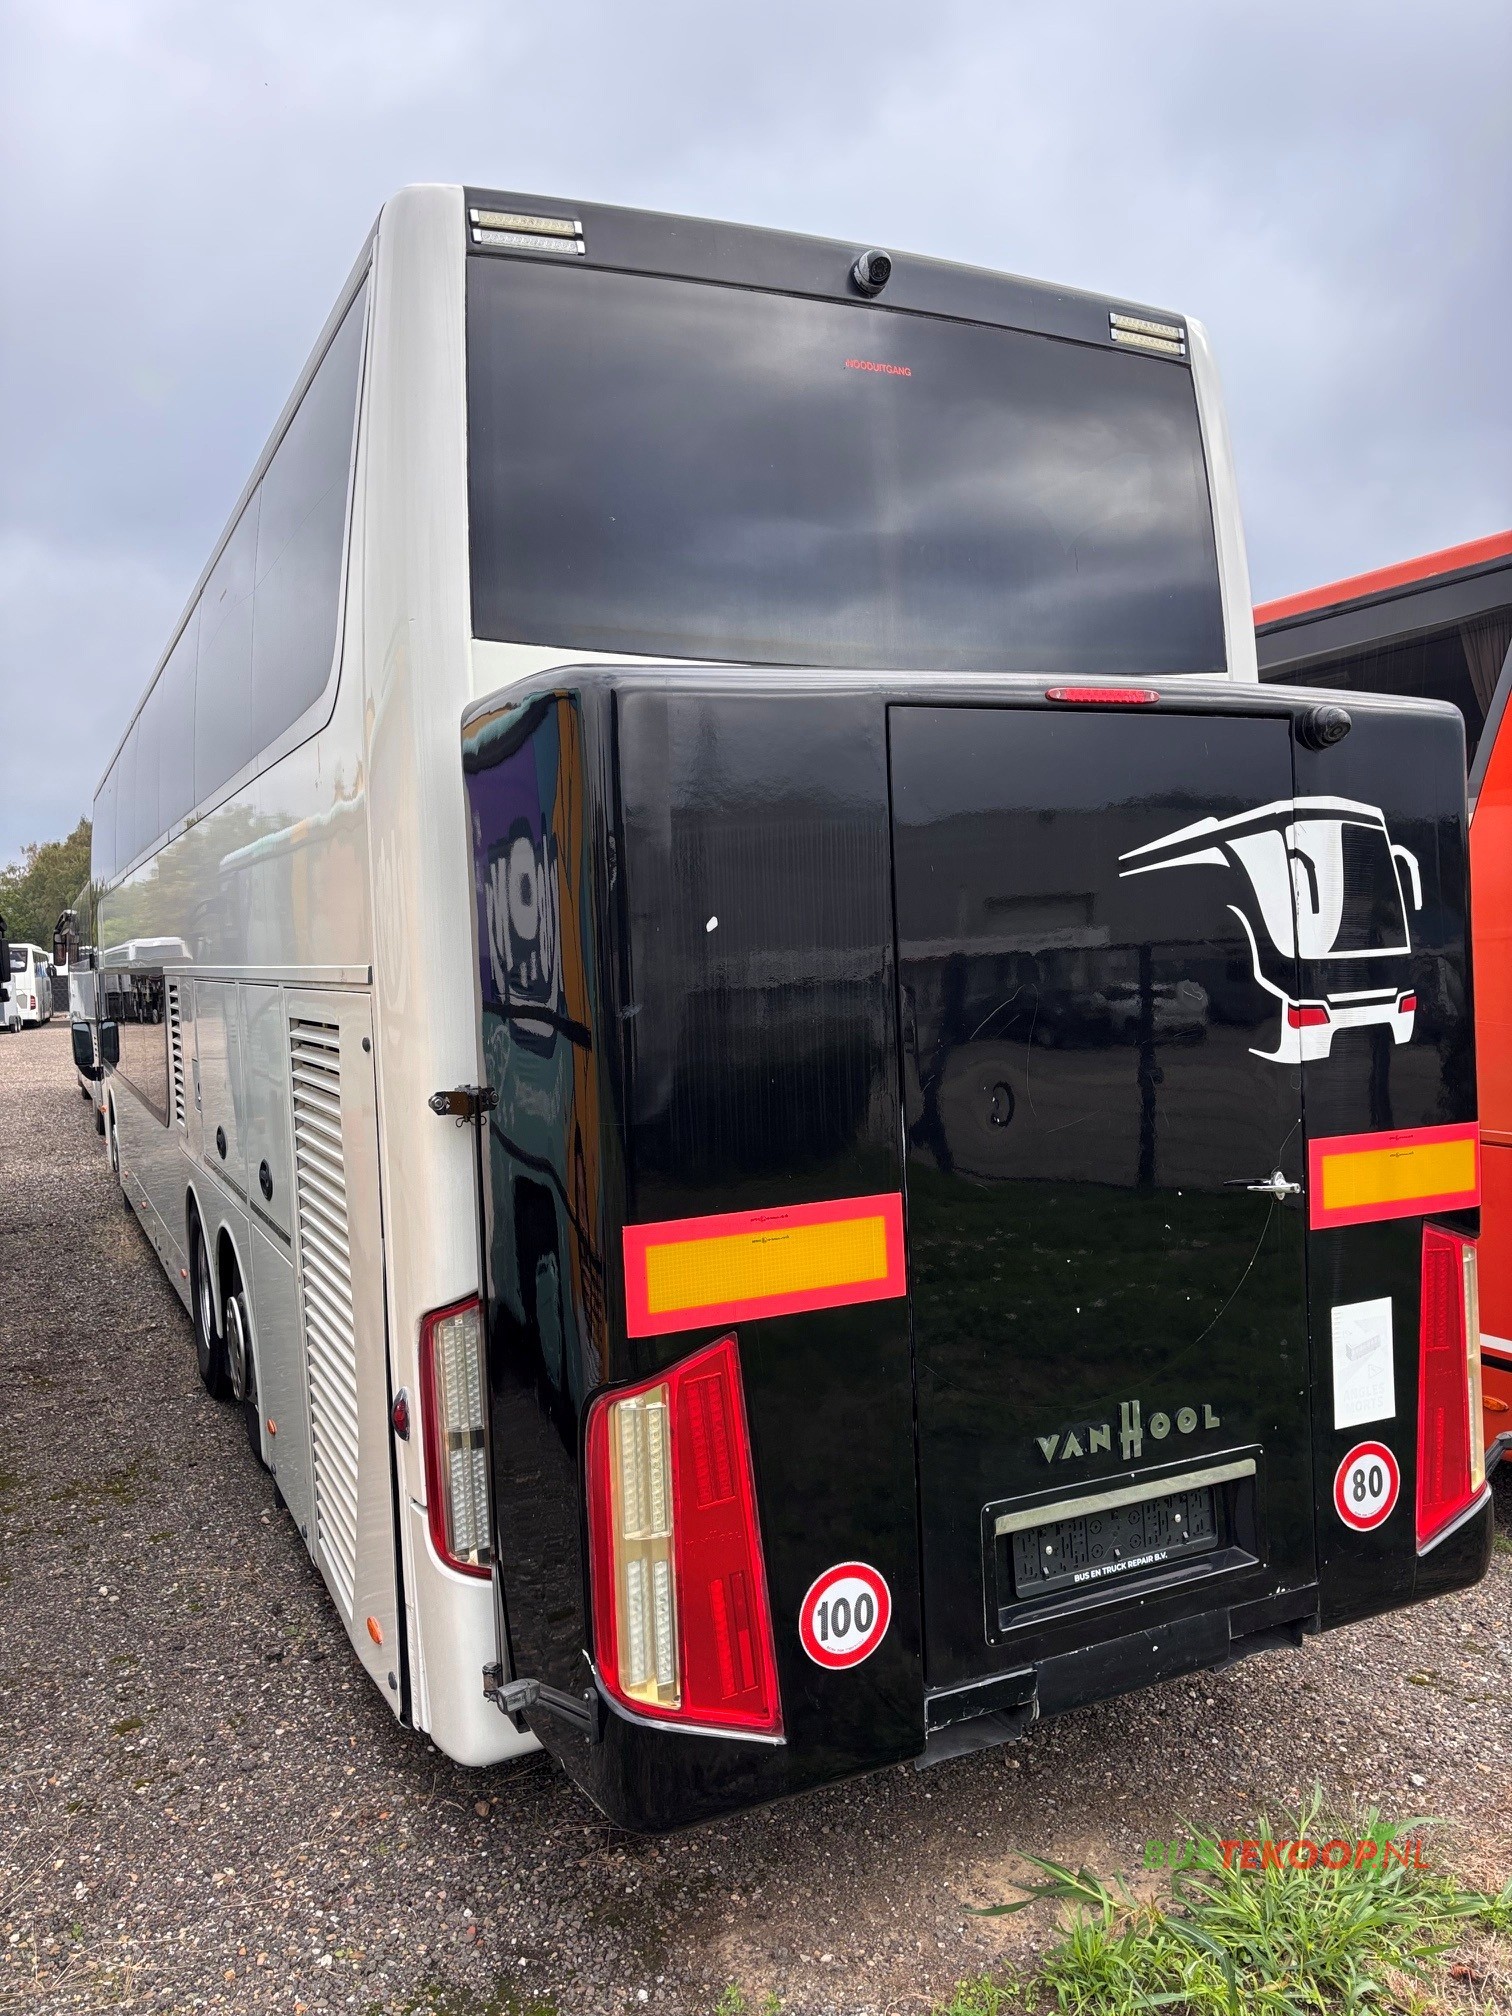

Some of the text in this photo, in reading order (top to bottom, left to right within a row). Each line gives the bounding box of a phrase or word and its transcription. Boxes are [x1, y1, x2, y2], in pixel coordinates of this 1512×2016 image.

[845, 358, 912, 376] NOODUITGANG
[1352, 1465, 1384, 1503] 80
[1074, 1551, 1168, 1582] BUS EN TRUCK REPAIR B.V.
[817, 1592, 874, 1641] 100
